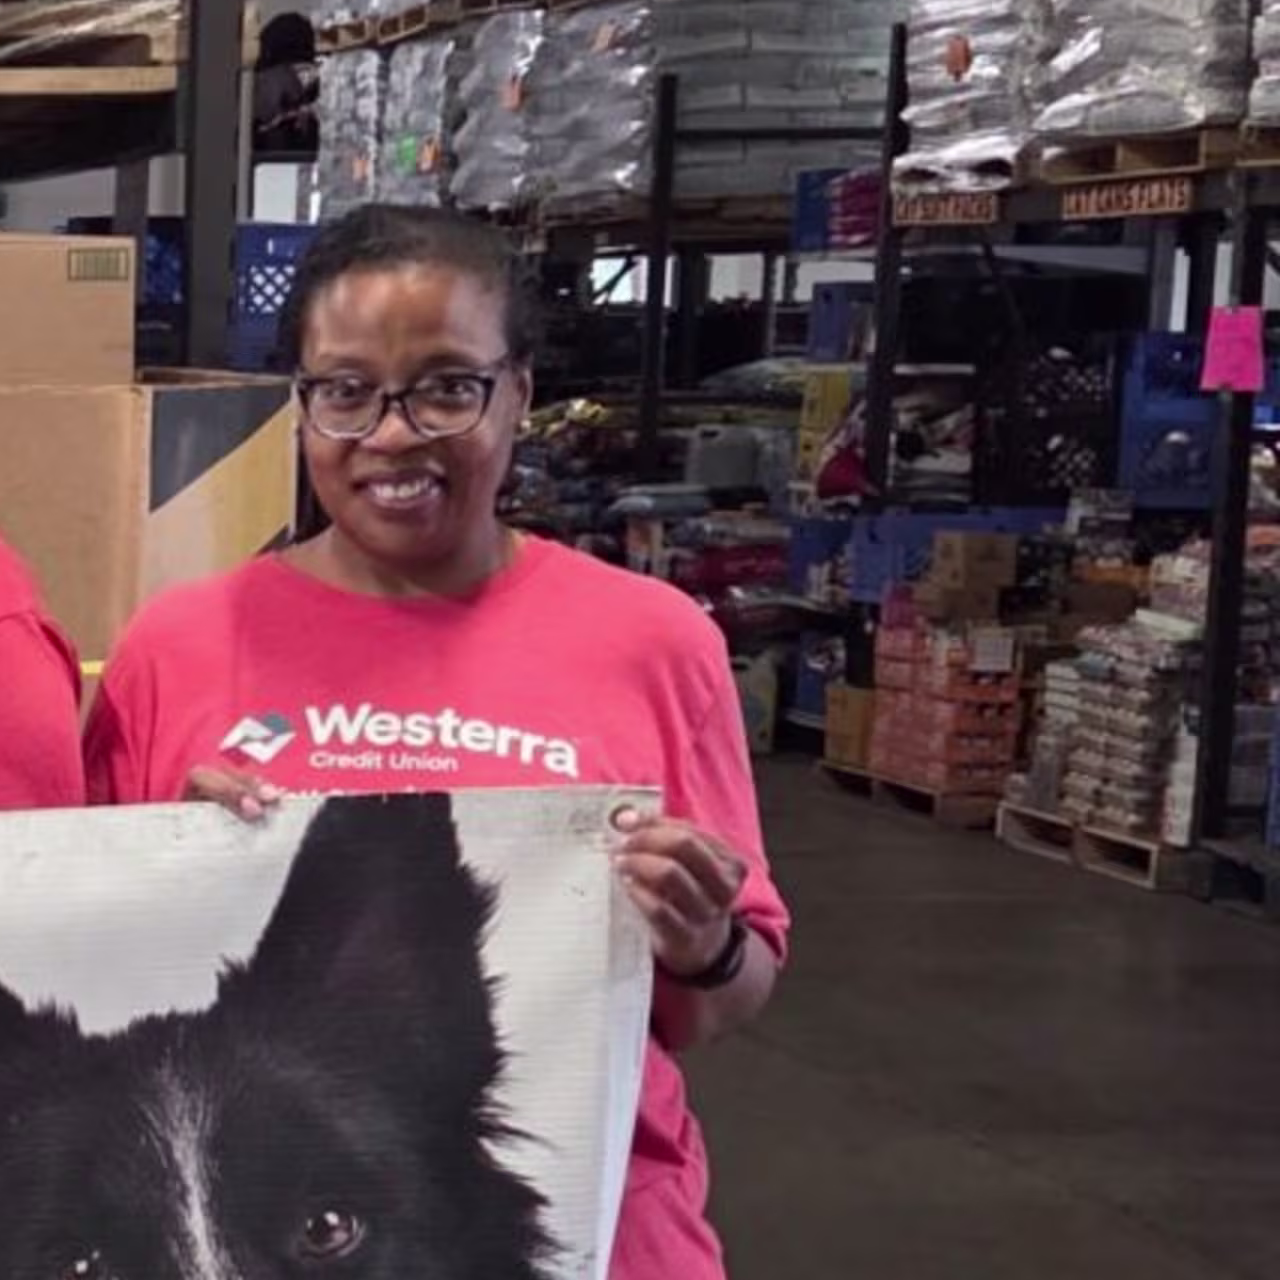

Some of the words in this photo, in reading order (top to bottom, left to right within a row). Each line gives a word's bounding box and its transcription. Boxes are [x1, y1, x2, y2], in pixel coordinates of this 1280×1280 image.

[304, 703, 580, 778] Westerra
[309, 751, 383, 770] Credit
[389, 751, 459, 772] Union
